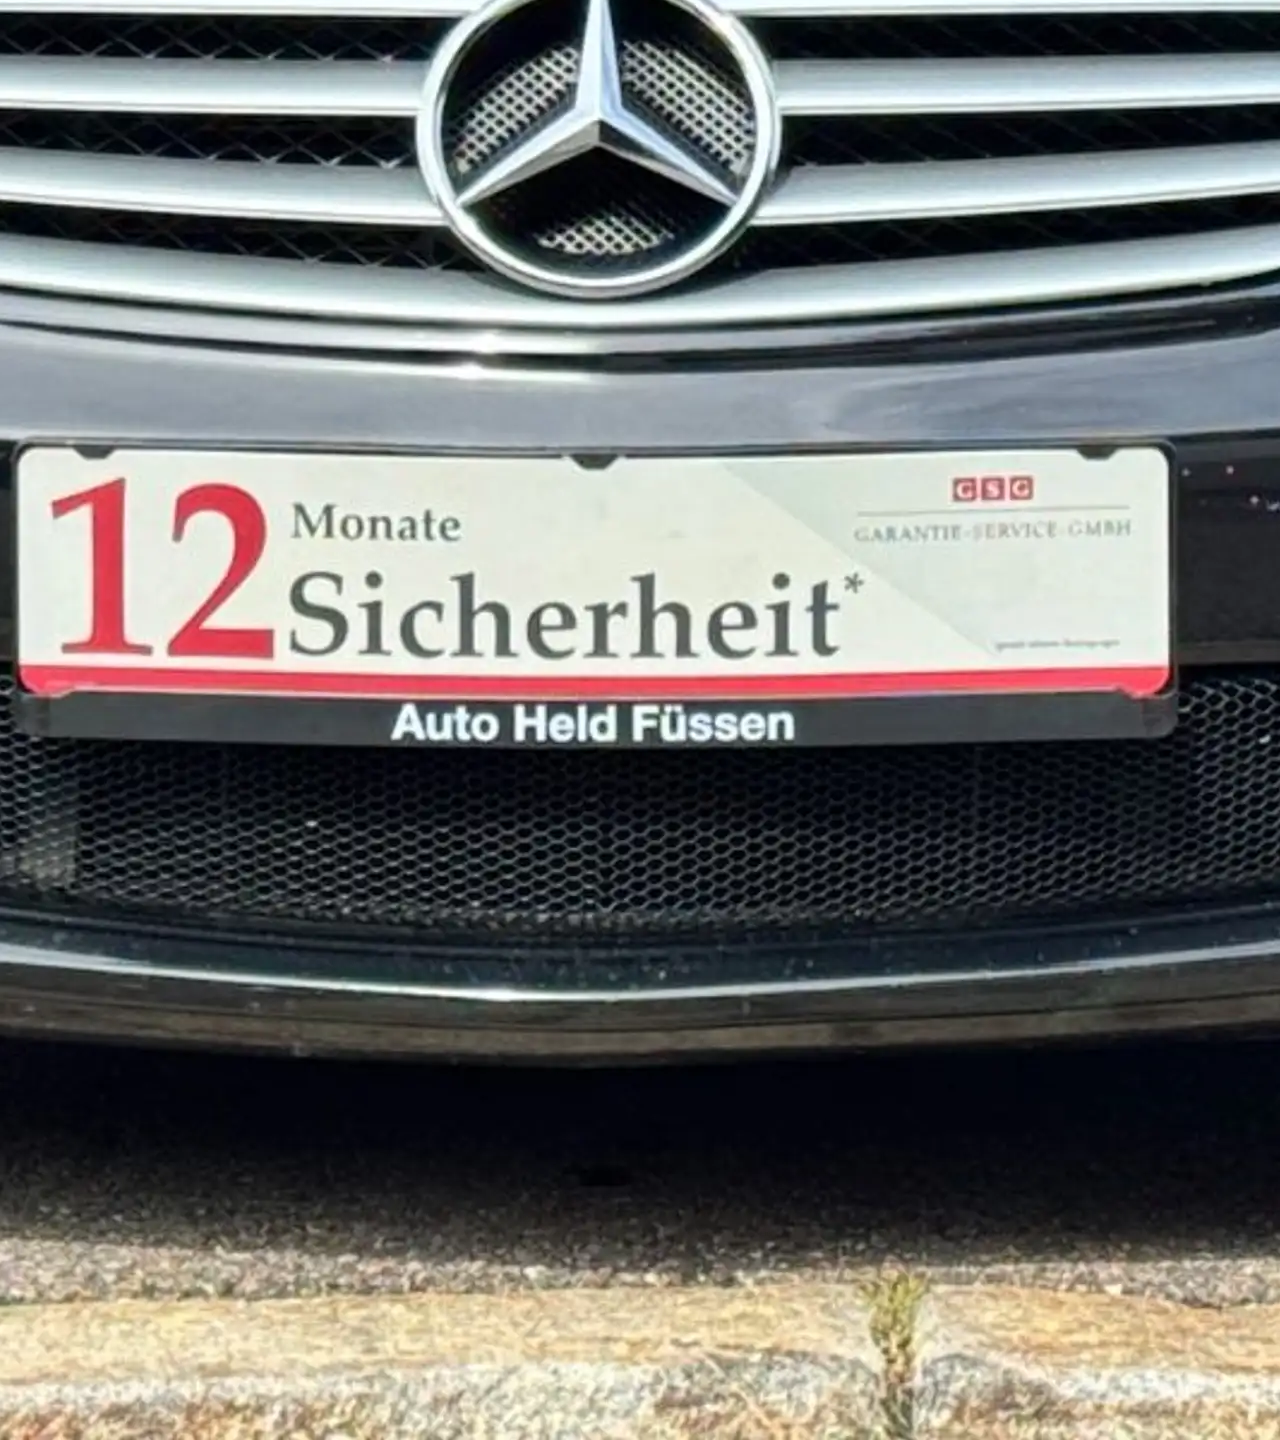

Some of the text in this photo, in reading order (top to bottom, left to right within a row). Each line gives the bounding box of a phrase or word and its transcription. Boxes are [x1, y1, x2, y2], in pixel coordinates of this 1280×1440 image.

[291, 502, 461, 541] Monate
[50, 477, 274, 659] 12
[391, 703, 796, 743] Auto Held Füssen
